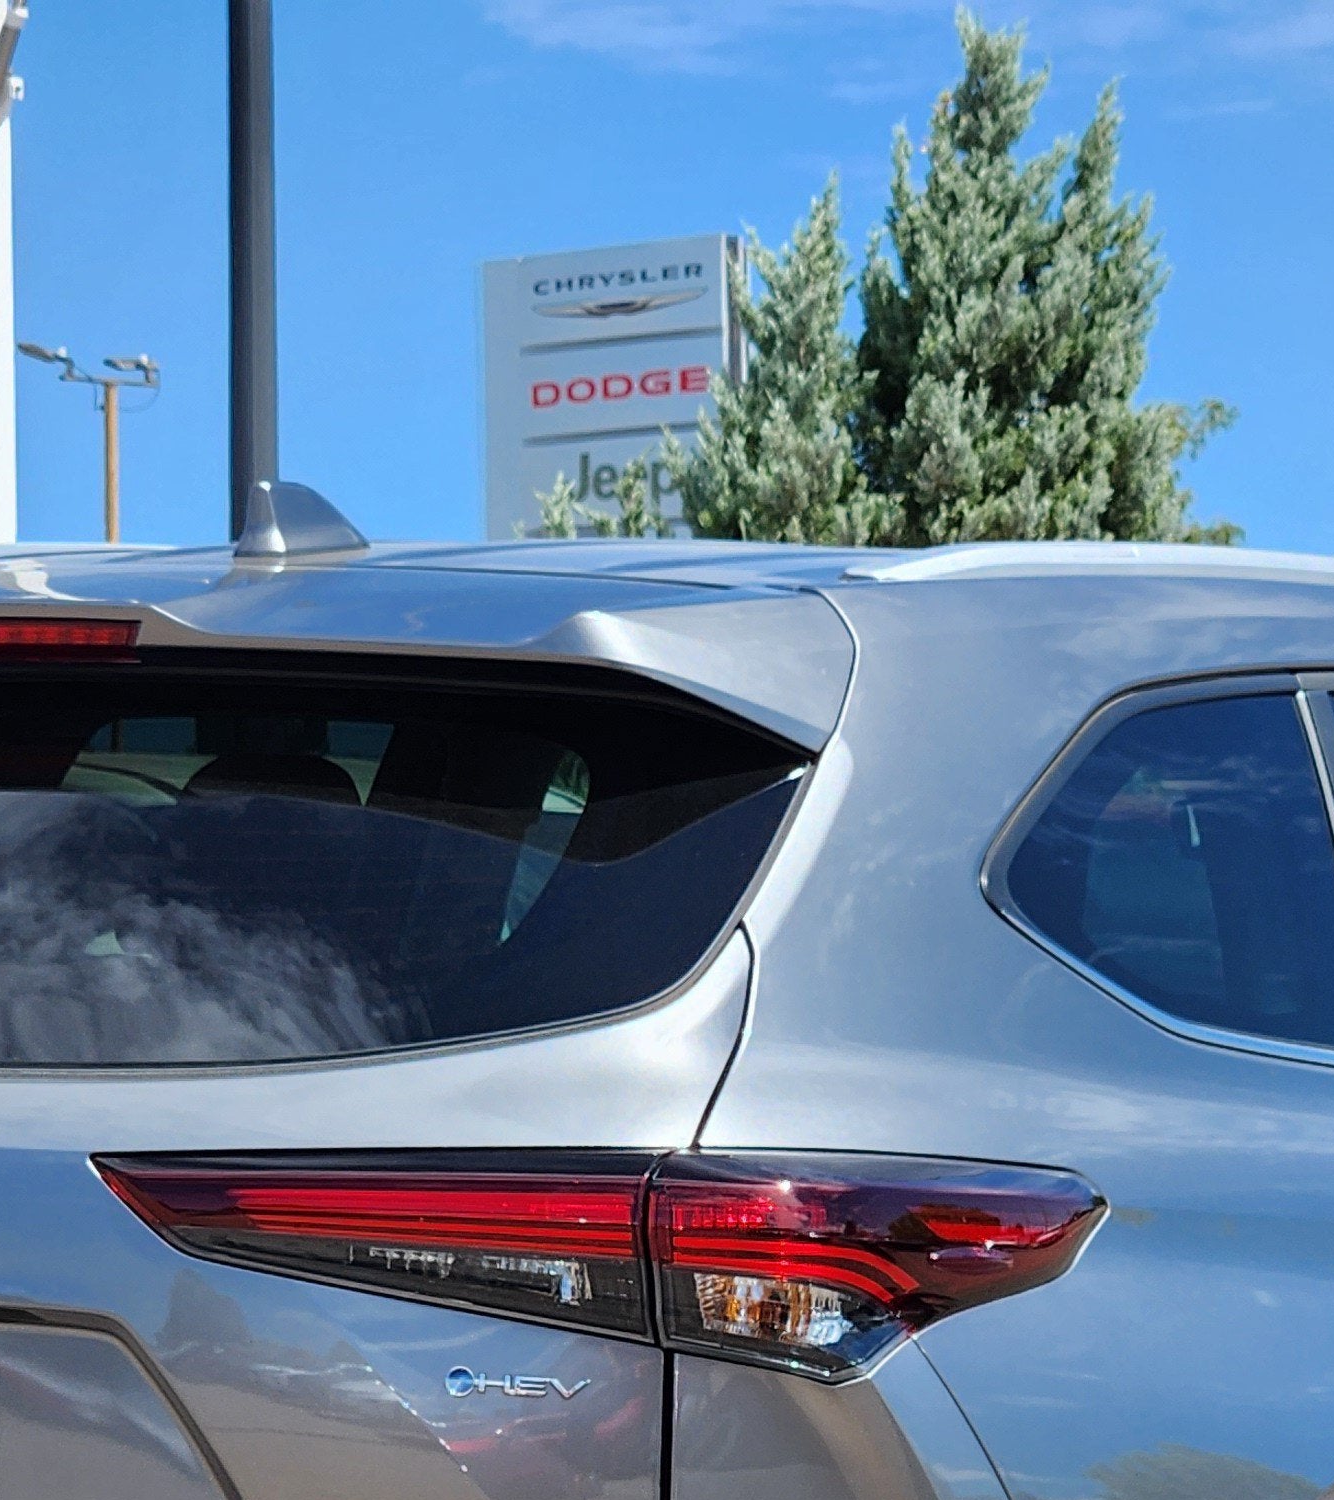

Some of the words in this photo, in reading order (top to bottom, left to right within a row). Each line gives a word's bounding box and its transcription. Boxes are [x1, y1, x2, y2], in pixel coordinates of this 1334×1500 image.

[532, 262, 704, 296] CHRYSLER
[531, 365, 710, 409] DODGE
[572, 452, 679, 516] Jep
[476, 1371, 592, 1399] HEV
